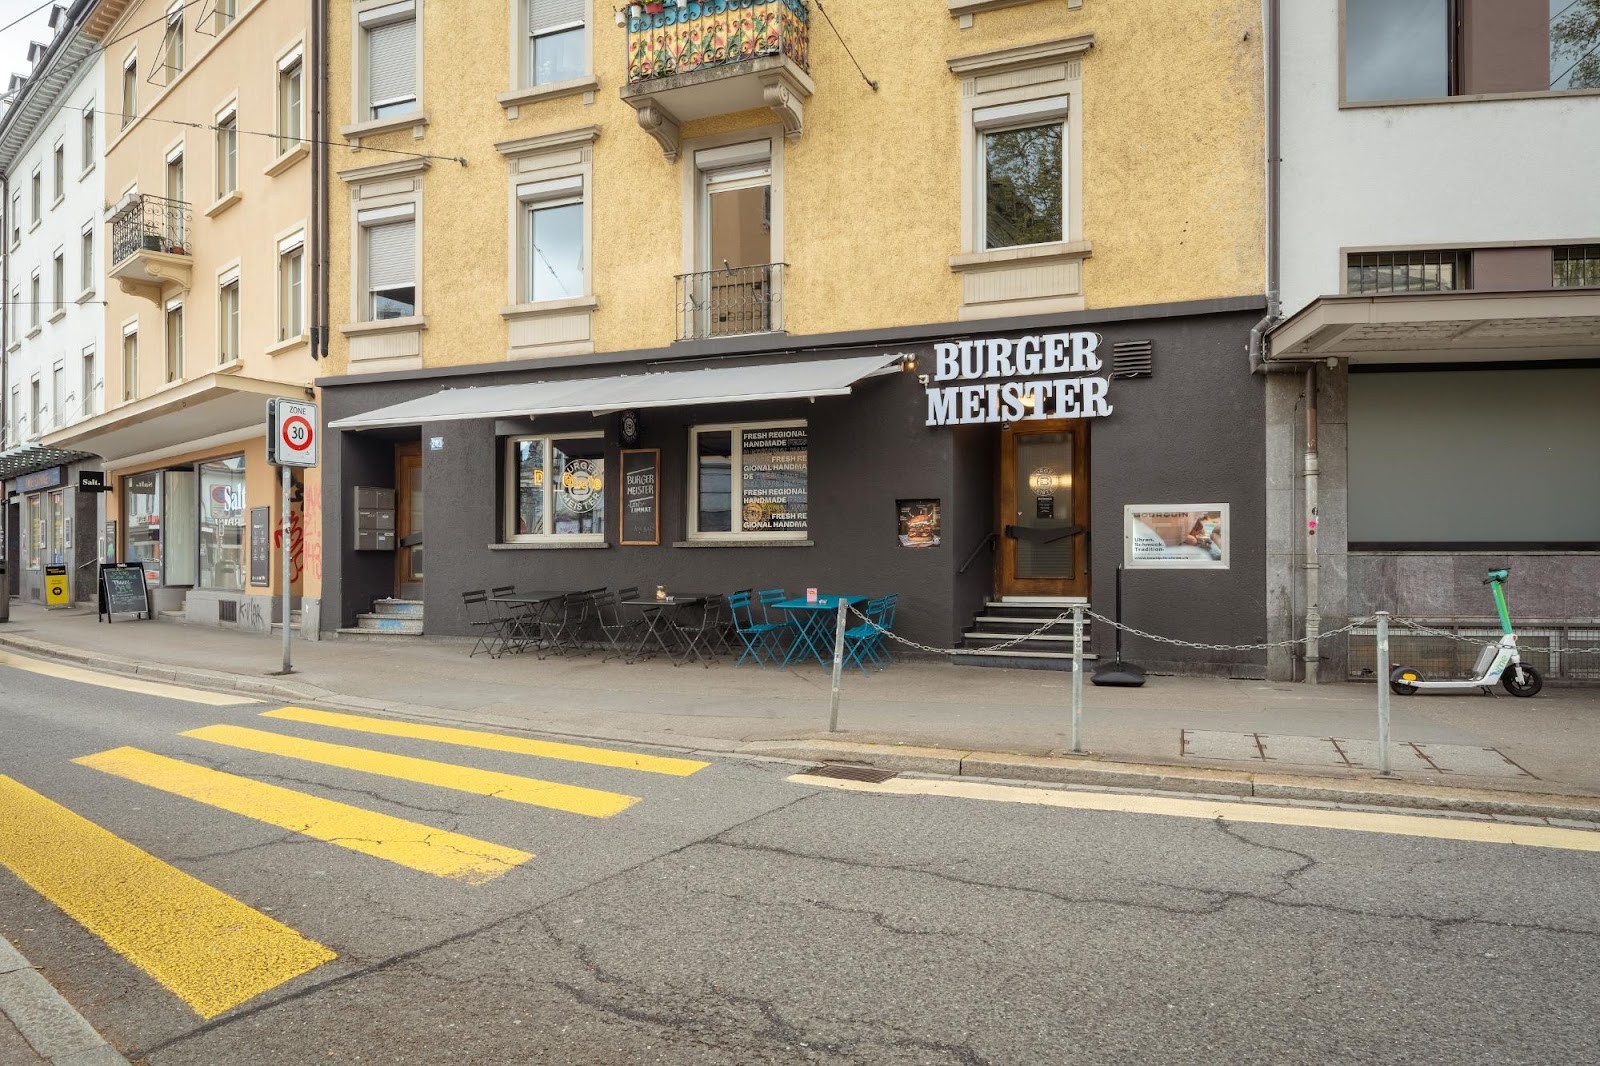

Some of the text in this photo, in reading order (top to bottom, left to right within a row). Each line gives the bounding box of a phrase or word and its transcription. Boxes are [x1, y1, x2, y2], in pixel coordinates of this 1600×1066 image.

[934, 332, 1102, 381] BURGER
[925, 377, 1113, 426] MEISTER
[289, 406, 306, 415] ZONE
[291, 426, 304, 440] 30
[744, 431, 807, 440] FRESH REGIONAL
[744, 440, 787, 448] HANDMADE
[82, 478, 101, 486] Salt.
[627, 474, 654, 485] BURGER
[627, 484, 654, 495] MEISTER
[562, 492, 601, 511] MEISTER
[773, 520, 807, 528] HANDMA
